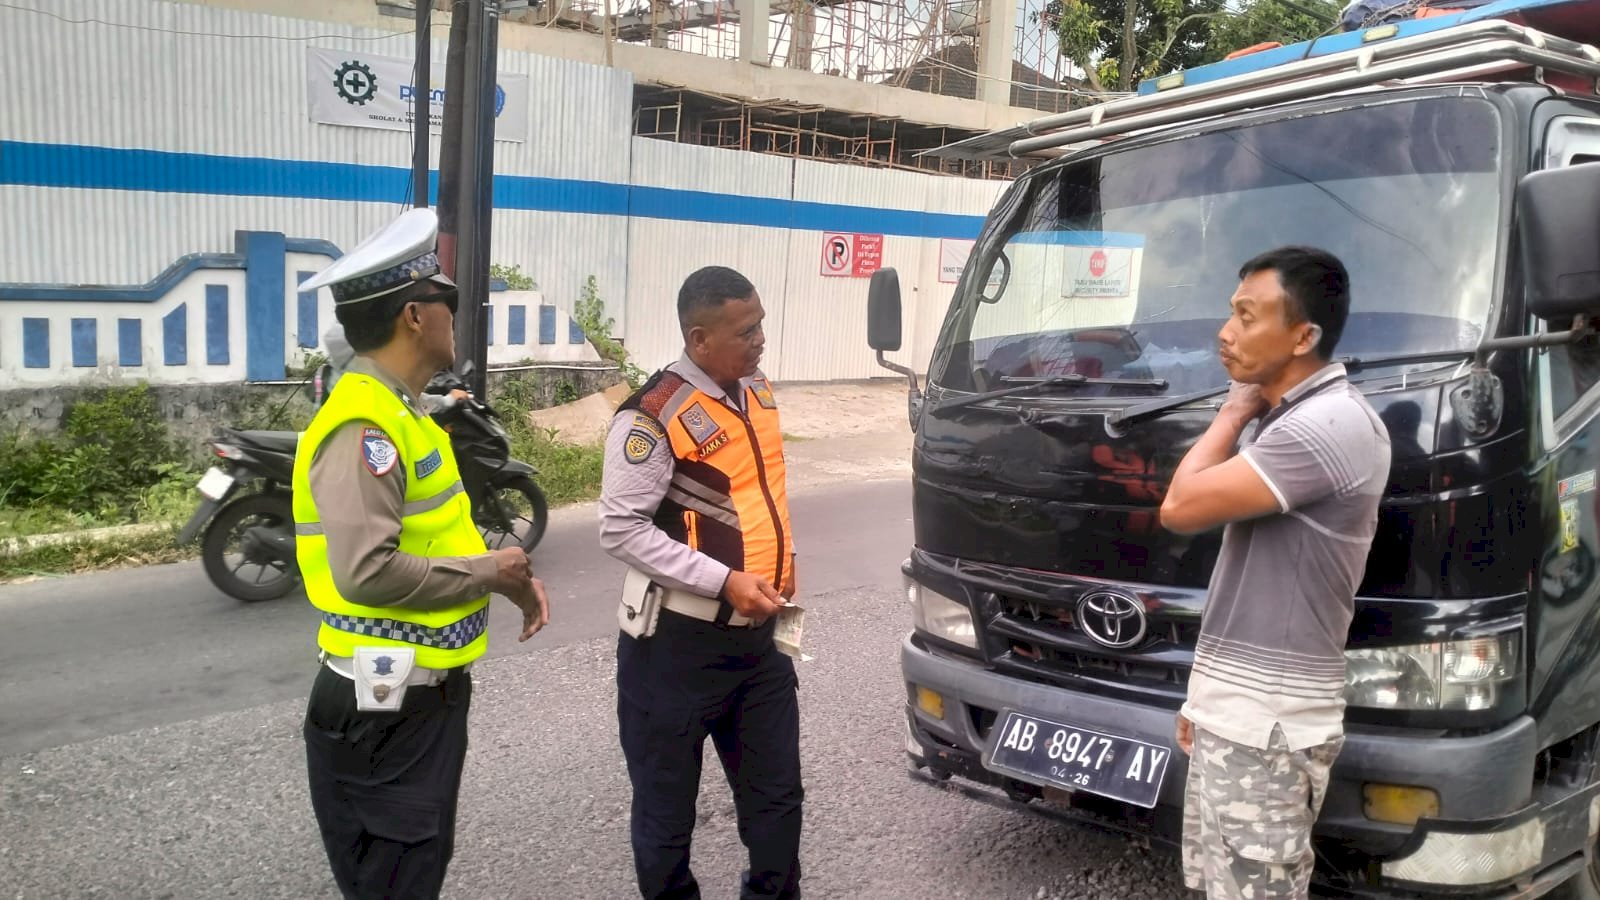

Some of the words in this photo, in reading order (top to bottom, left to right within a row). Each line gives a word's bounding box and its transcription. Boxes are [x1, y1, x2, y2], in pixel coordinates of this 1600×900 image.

[700, 439, 721, 457] JAKA
[720, 433, 728, 442] S
[1003, 718, 1038, 752] AB
[1047, 729, 1113, 771] 8947
[1126, 745, 1165, 784] AY
